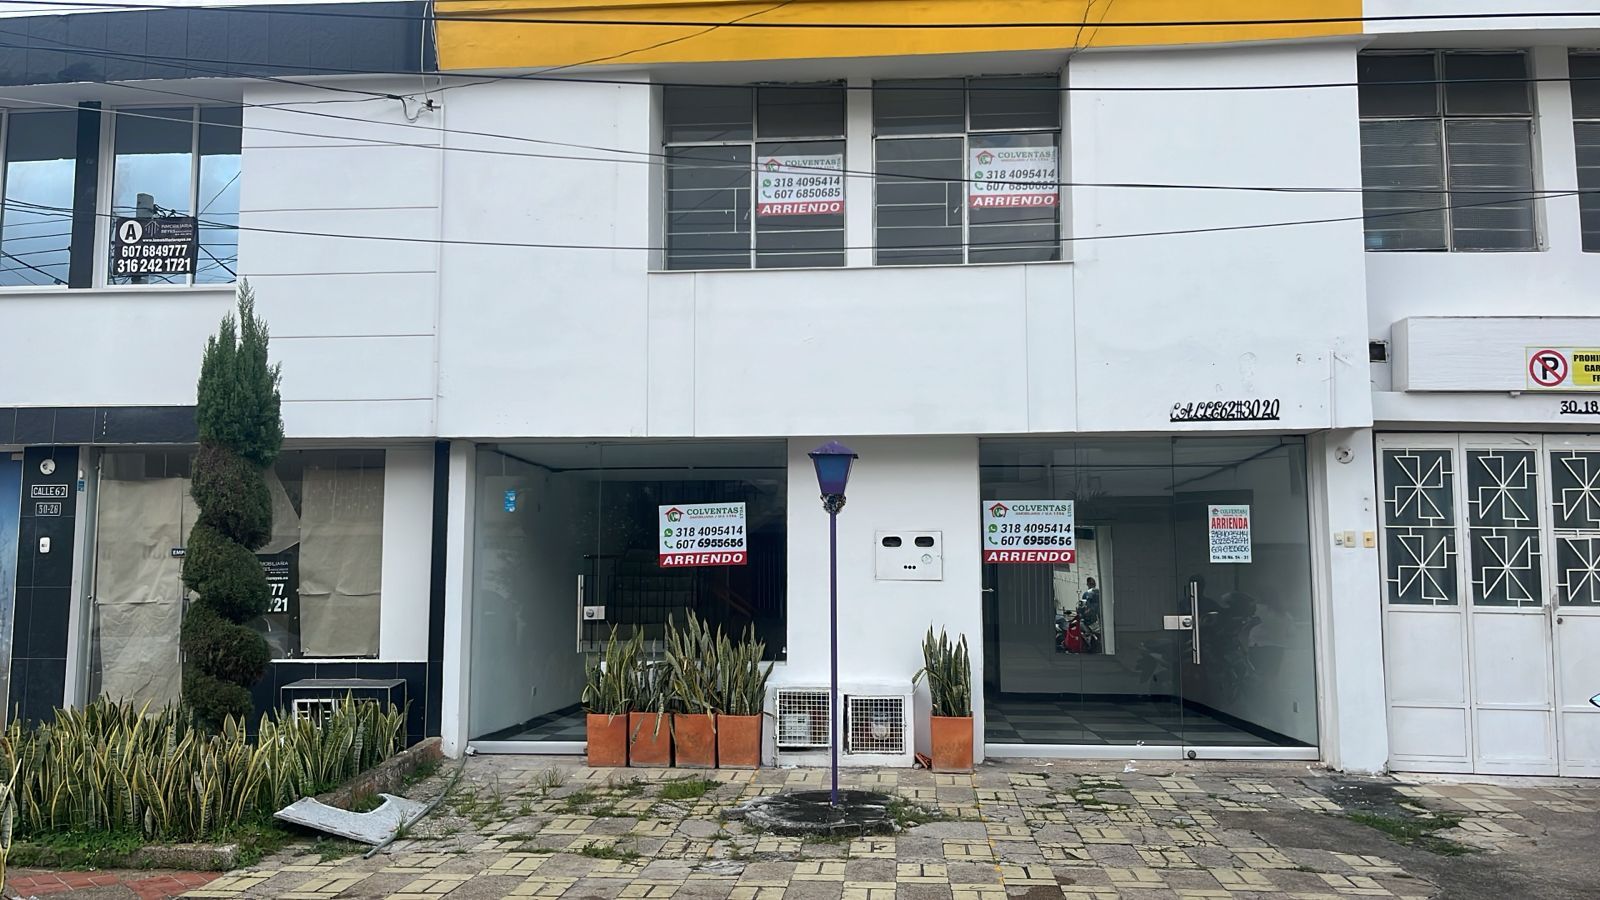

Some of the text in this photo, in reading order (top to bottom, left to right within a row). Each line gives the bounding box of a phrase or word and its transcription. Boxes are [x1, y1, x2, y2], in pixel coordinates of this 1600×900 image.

[997, 151, 1051, 159] COLVENTAS
[784, 159, 837, 167] COLVENTAS
[986, 169, 1056, 179] 318 4095414
[774, 176, 841, 188] 318 4095414
[986, 182, 1006, 191] 607
[774, 187, 841, 199] 607 6850685
[973, 195, 1055, 206] ARRIENDO
[761, 202, 841, 214] ARRIENDO
[122, 245, 188, 257] 607 6849777
[117, 257, 191, 273] 316 242 1721
[33, 486, 66, 496] CALLE 62
[686, 507, 739, 516] COLVENTAS
[1012, 504, 1067, 512] COLVENTAS
[1001, 523, 1071, 533] 318 4095414
[1211, 517, 1249, 530] ARRIENDA
[676, 525, 743, 537] 318 4095414
[676, 538, 743, 549] 607 6955656
[1001, 535, 1072, 545] 607 6955656
[662, 553, 743, 566] ARRIENDO
[987, 551, 1071, 562] ARRIENDO
